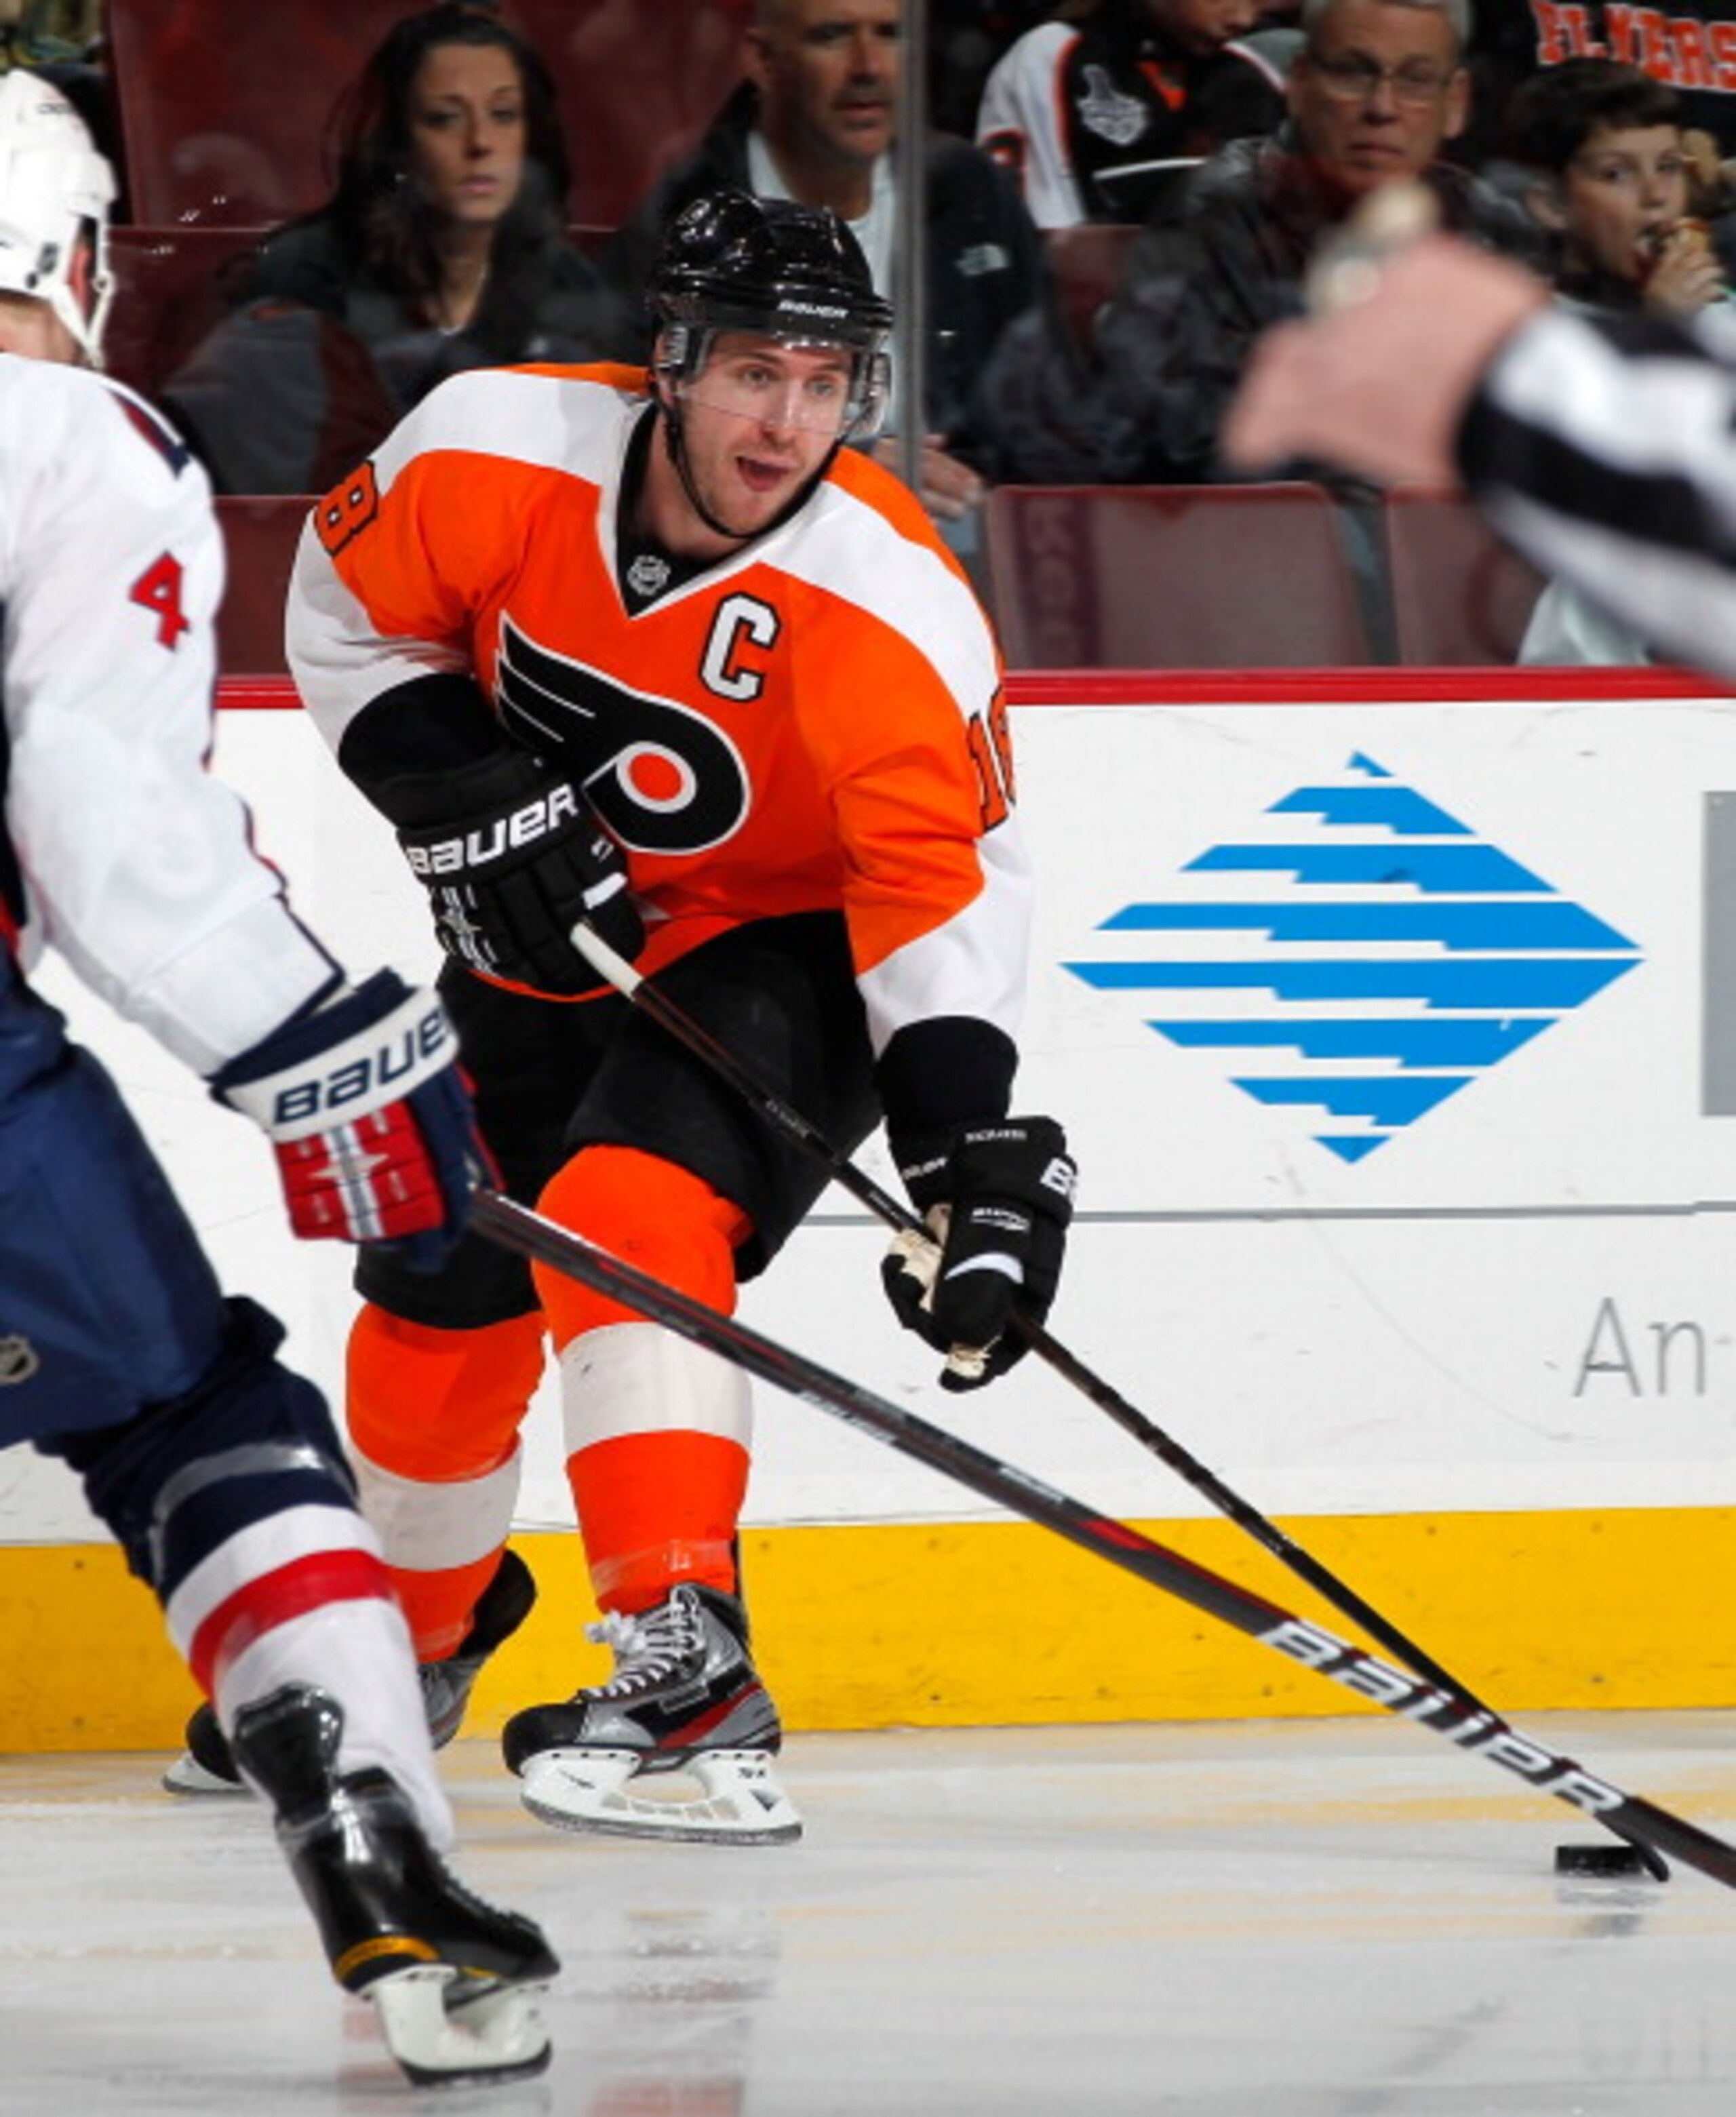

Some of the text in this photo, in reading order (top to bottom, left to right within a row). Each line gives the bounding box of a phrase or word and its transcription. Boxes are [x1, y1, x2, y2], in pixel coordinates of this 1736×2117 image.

[1527, 0, 1736, 93] FLYERS
[128, 550, 189, 651] 4
[699, 591, 781, 703] C
[1572, 1297, 1705, 1398] An
